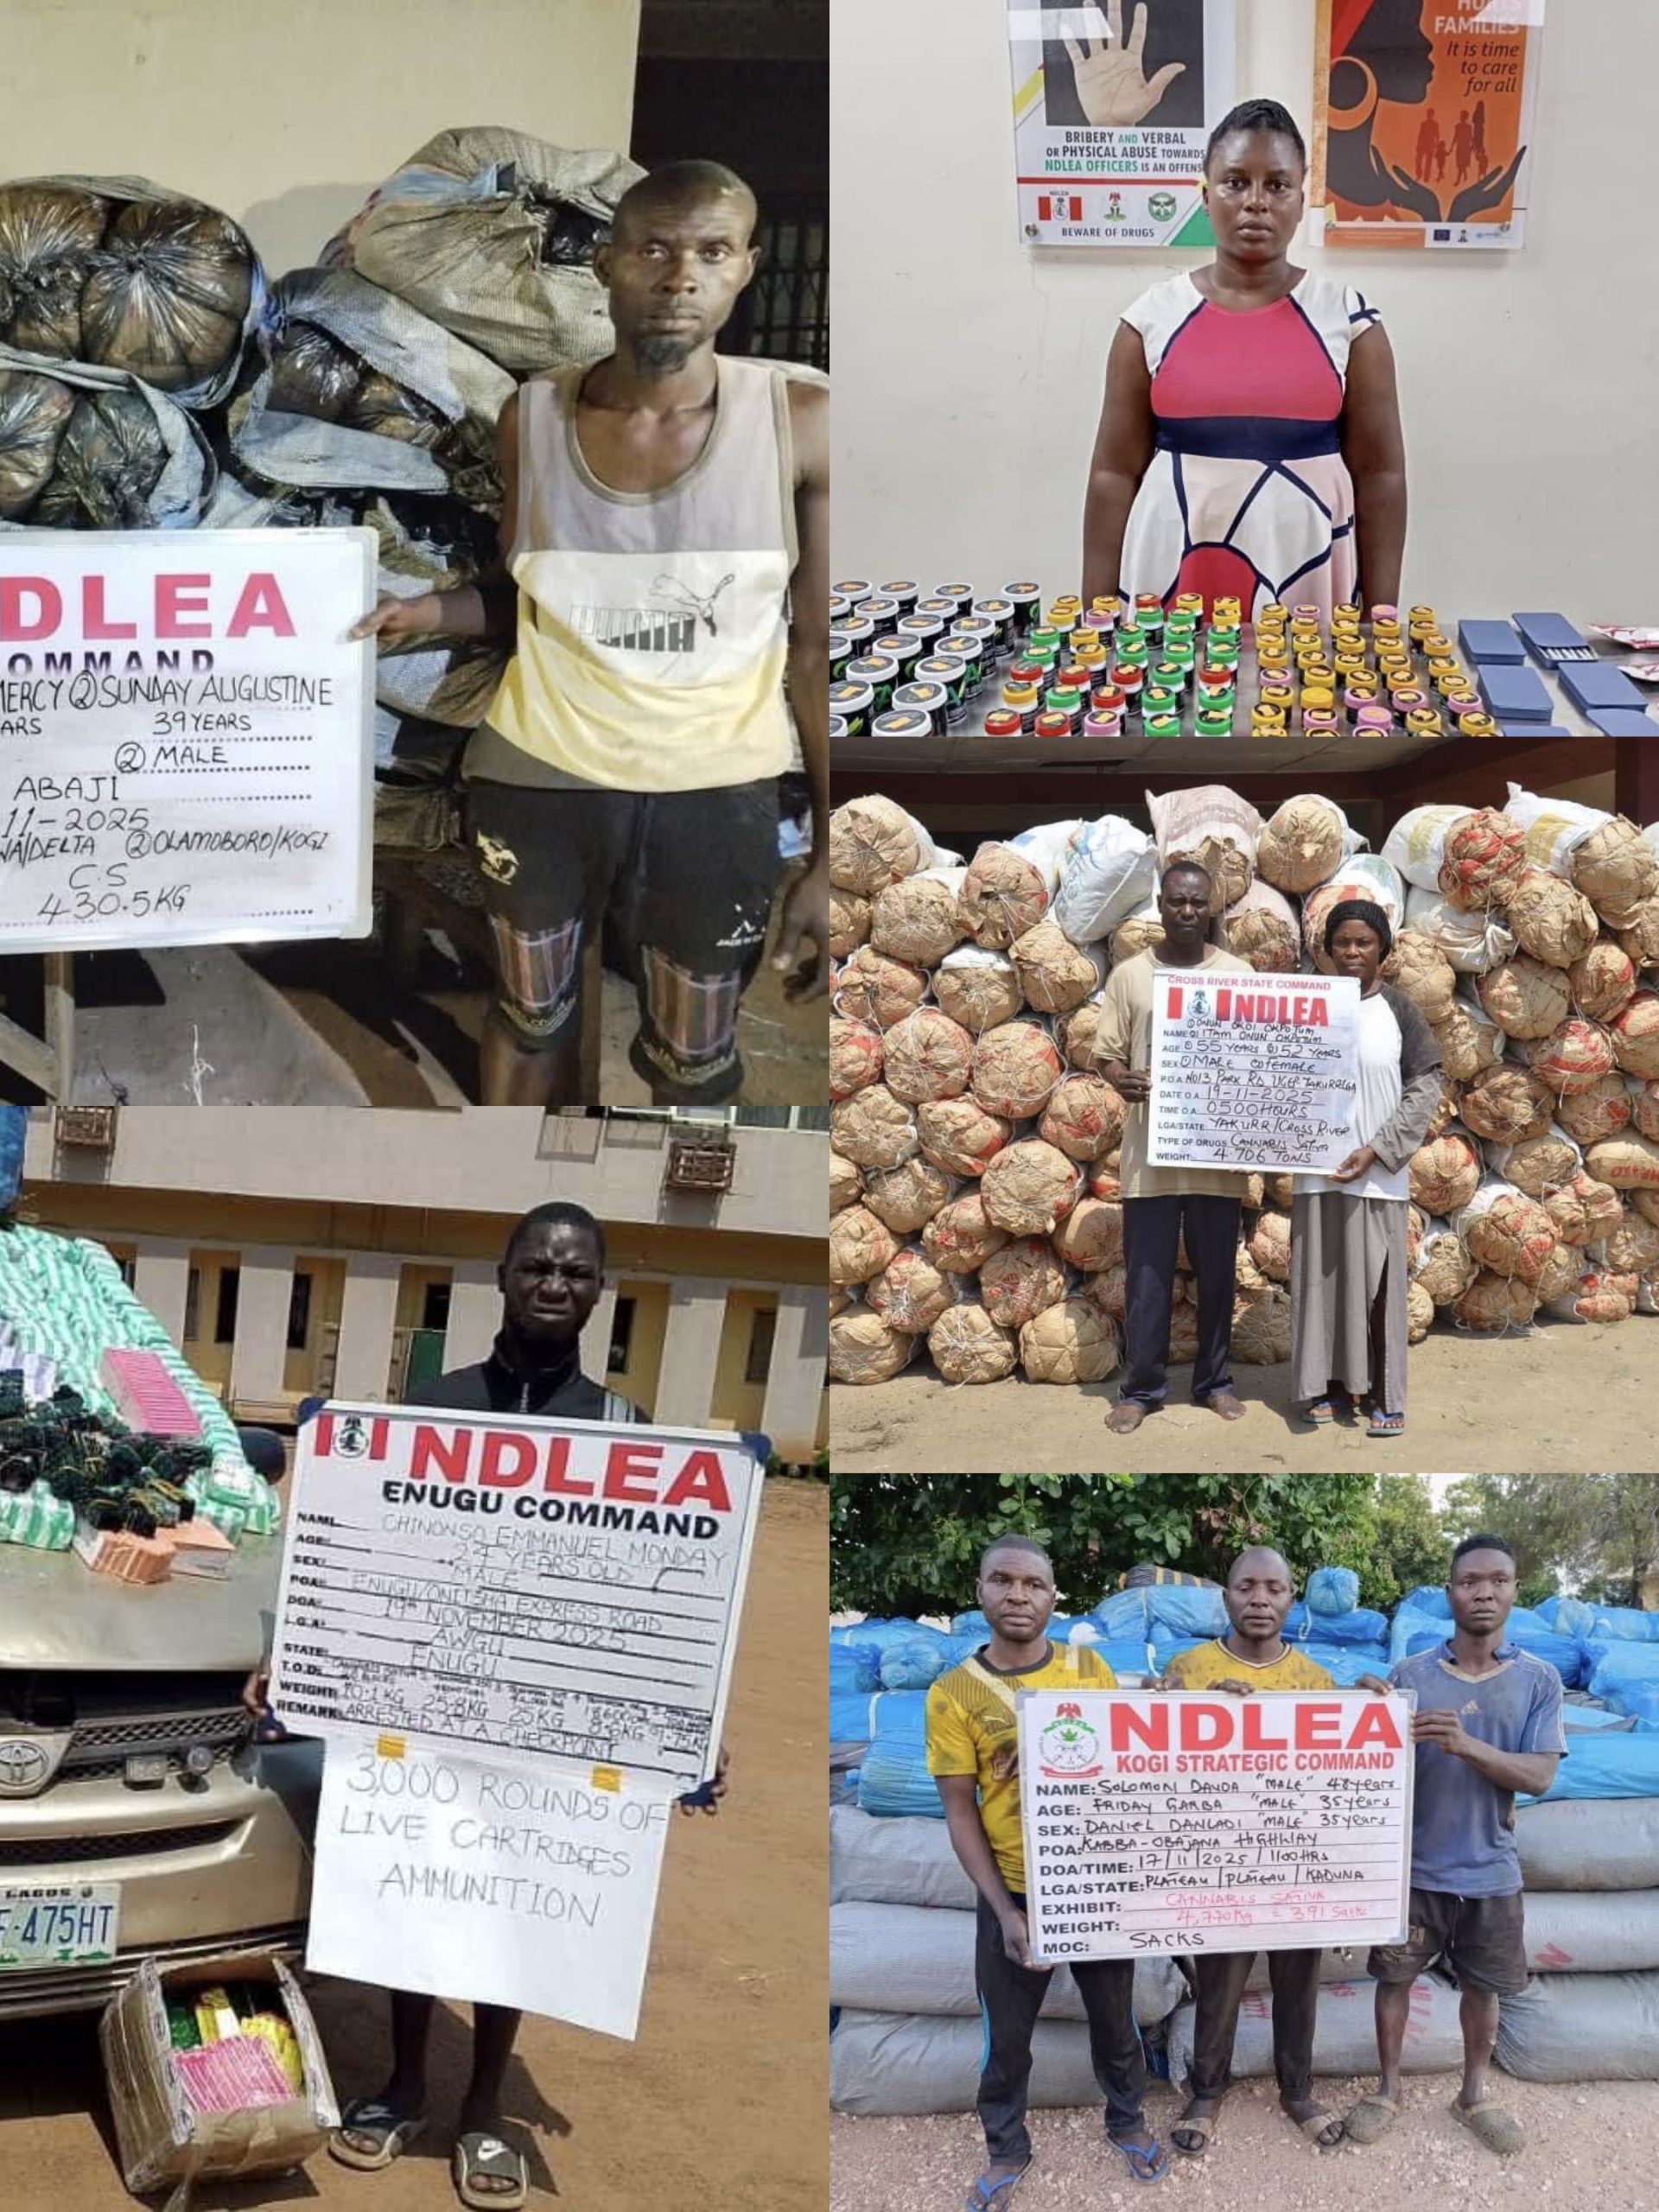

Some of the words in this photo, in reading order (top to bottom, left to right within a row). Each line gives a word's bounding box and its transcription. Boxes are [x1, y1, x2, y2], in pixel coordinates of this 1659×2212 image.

[1434, 16, 1520, 35] FAMILIES
[1446, 40, 1459, 56] It
[1465, 41, 1477, 57] is
[1482, 41, 1520, 57] time
[1461, 61, 1478, 74] to
[1482, 62, 1518, 75] care
[1463, 76, 1491, 97] for
[1494, 77, 1516, 92] all
[1065, 131, 1114, 143] BRIBERY
[1118, 134, 1138, 143] AND
[1141, 132, 1186, 144] VERBAL
[1046, 147, 1059, 157] OR
[1063, 146, 1117, 158] PHYSICAL
[1122, 147, 1157, 158] ABUSE
[1161, 149, 1205, 158] TOWARDS
[1046, 161, 1082, 172] NDLEA
[1086, 161, 1138, 172] OFFICERS
[1141, 163, 1150, 172] IS
[1153, 163, 1166, 172] AN
[1062, 227, 1101, 238] BEWARE
[1105, 228, 1119, 238] OF
[1122, 228, 1155, 238] DRUGS
[198, 675, 334, 706] AUGUSTINE
[153, 746, 228, 767] MALE
[13, 776, 119, 802] ABAJI
[1168, 975, 1205, 986] CROSS
[1207, 977, 1238, 987] RIVER
[1240, 979, 1273, 988] STATE
[1276, 980, 1332, 991] COMMAND
[1235, 995, 1329, 1027] NDLEA
[1196, 1039, 1223, 1052] 55
[1225, 1043, 1259, 1054] YEARS
[1281, 1045, 1303, 1058] 52
[1308, 1047, 1342, 1059] YEARS
[1193, 1055, 1235, 1070] MALE
[1265, 1057, 1316, 1073] FEMALE
[1217, 1069, 1241, 1086] PARK
[1160, 1090, 1183, 1099] DATE
[1159, 1106, 1179, 1115] TIME
[1316, 1121, 1351, 1136] RIVER
[1157, 1136, 1180, 1146] TYPE
[1230, 1132, 1287, 1150] CANNABIS
[1272, 1150, 1312, 1163] TONS
[409, 1425, 733, 1513] NDLEA
[382, 1480, 504, 1515] ENUGU
[513, 1495, 720, 1540] COMMAND
[383, 1514, 486, 1544] CHINONSO
[496, 1526, 617, 1560] EMMANUEL
[629, 1542, 728, 1576] MONDAY
[505, 1549, 580, 1579] YEARS
[588, 1560, 633, 1582] OLD
[452, 1565, 518, 1589] MALE
[609, 1608, 663, 1631] ROAD
[433, 1627, 505, 1657] AWGU
[553, 1622, 626, 1652] 2025
[410, 1643, 498, 1677] ENUGU
[346, 1702, 433, 1732] ARRESTED
[500, 1726, 619, 1760] CHECKPOINT
[1110, 1703, 1403, 1751] NDLEA
[1116, 1754, 1169, 1774] KOGI
[1176, 1753, 1288, 1773] STRATEGIC
[1296, 1751, 1395, 1770] COMMAND
[1036, 1783, 1096, 1796] NAME:
[479, 1771, 610, 1822] ROUNDS
[620, 1801, 666, 1831] OF
[1037, 1804, 1081, 1816] AGE:
[1092, 1797, 1153, 1815] FRIDAY
[1166, 1797, 1223, 1814] GARBA
[340, 1806, 427, 1840] LIVE
[1038, 1824, 1081, 1837] SEX:
[1084, 1819, 1154, 1834] DANIEL
[1039, 1845, 1083, 1857] POA:
[1039, 1862, 1134, 1877] DOA/TIME:
[1040, 1880, 1145, 1897] LGA/STATE:
[1145, 1872, 1210, 1889] PLATEAU
[1306, 1866, 1365, 1885] KADUNA
[5, 1887, 73, 1899] LAGOS
[378, 1863, 601, 1928] AMMUNITION
[1041, 1901, 1122, 1916] EXHIBIT:
[1166, 1891, 1257, 1907] CANNABIS
[1042, 1920, 1121, 1936] WEIGHT:
[1043, 1941, 1090, 1955] MOC:
[1129, 1931, 1205, 1949] SACKS
